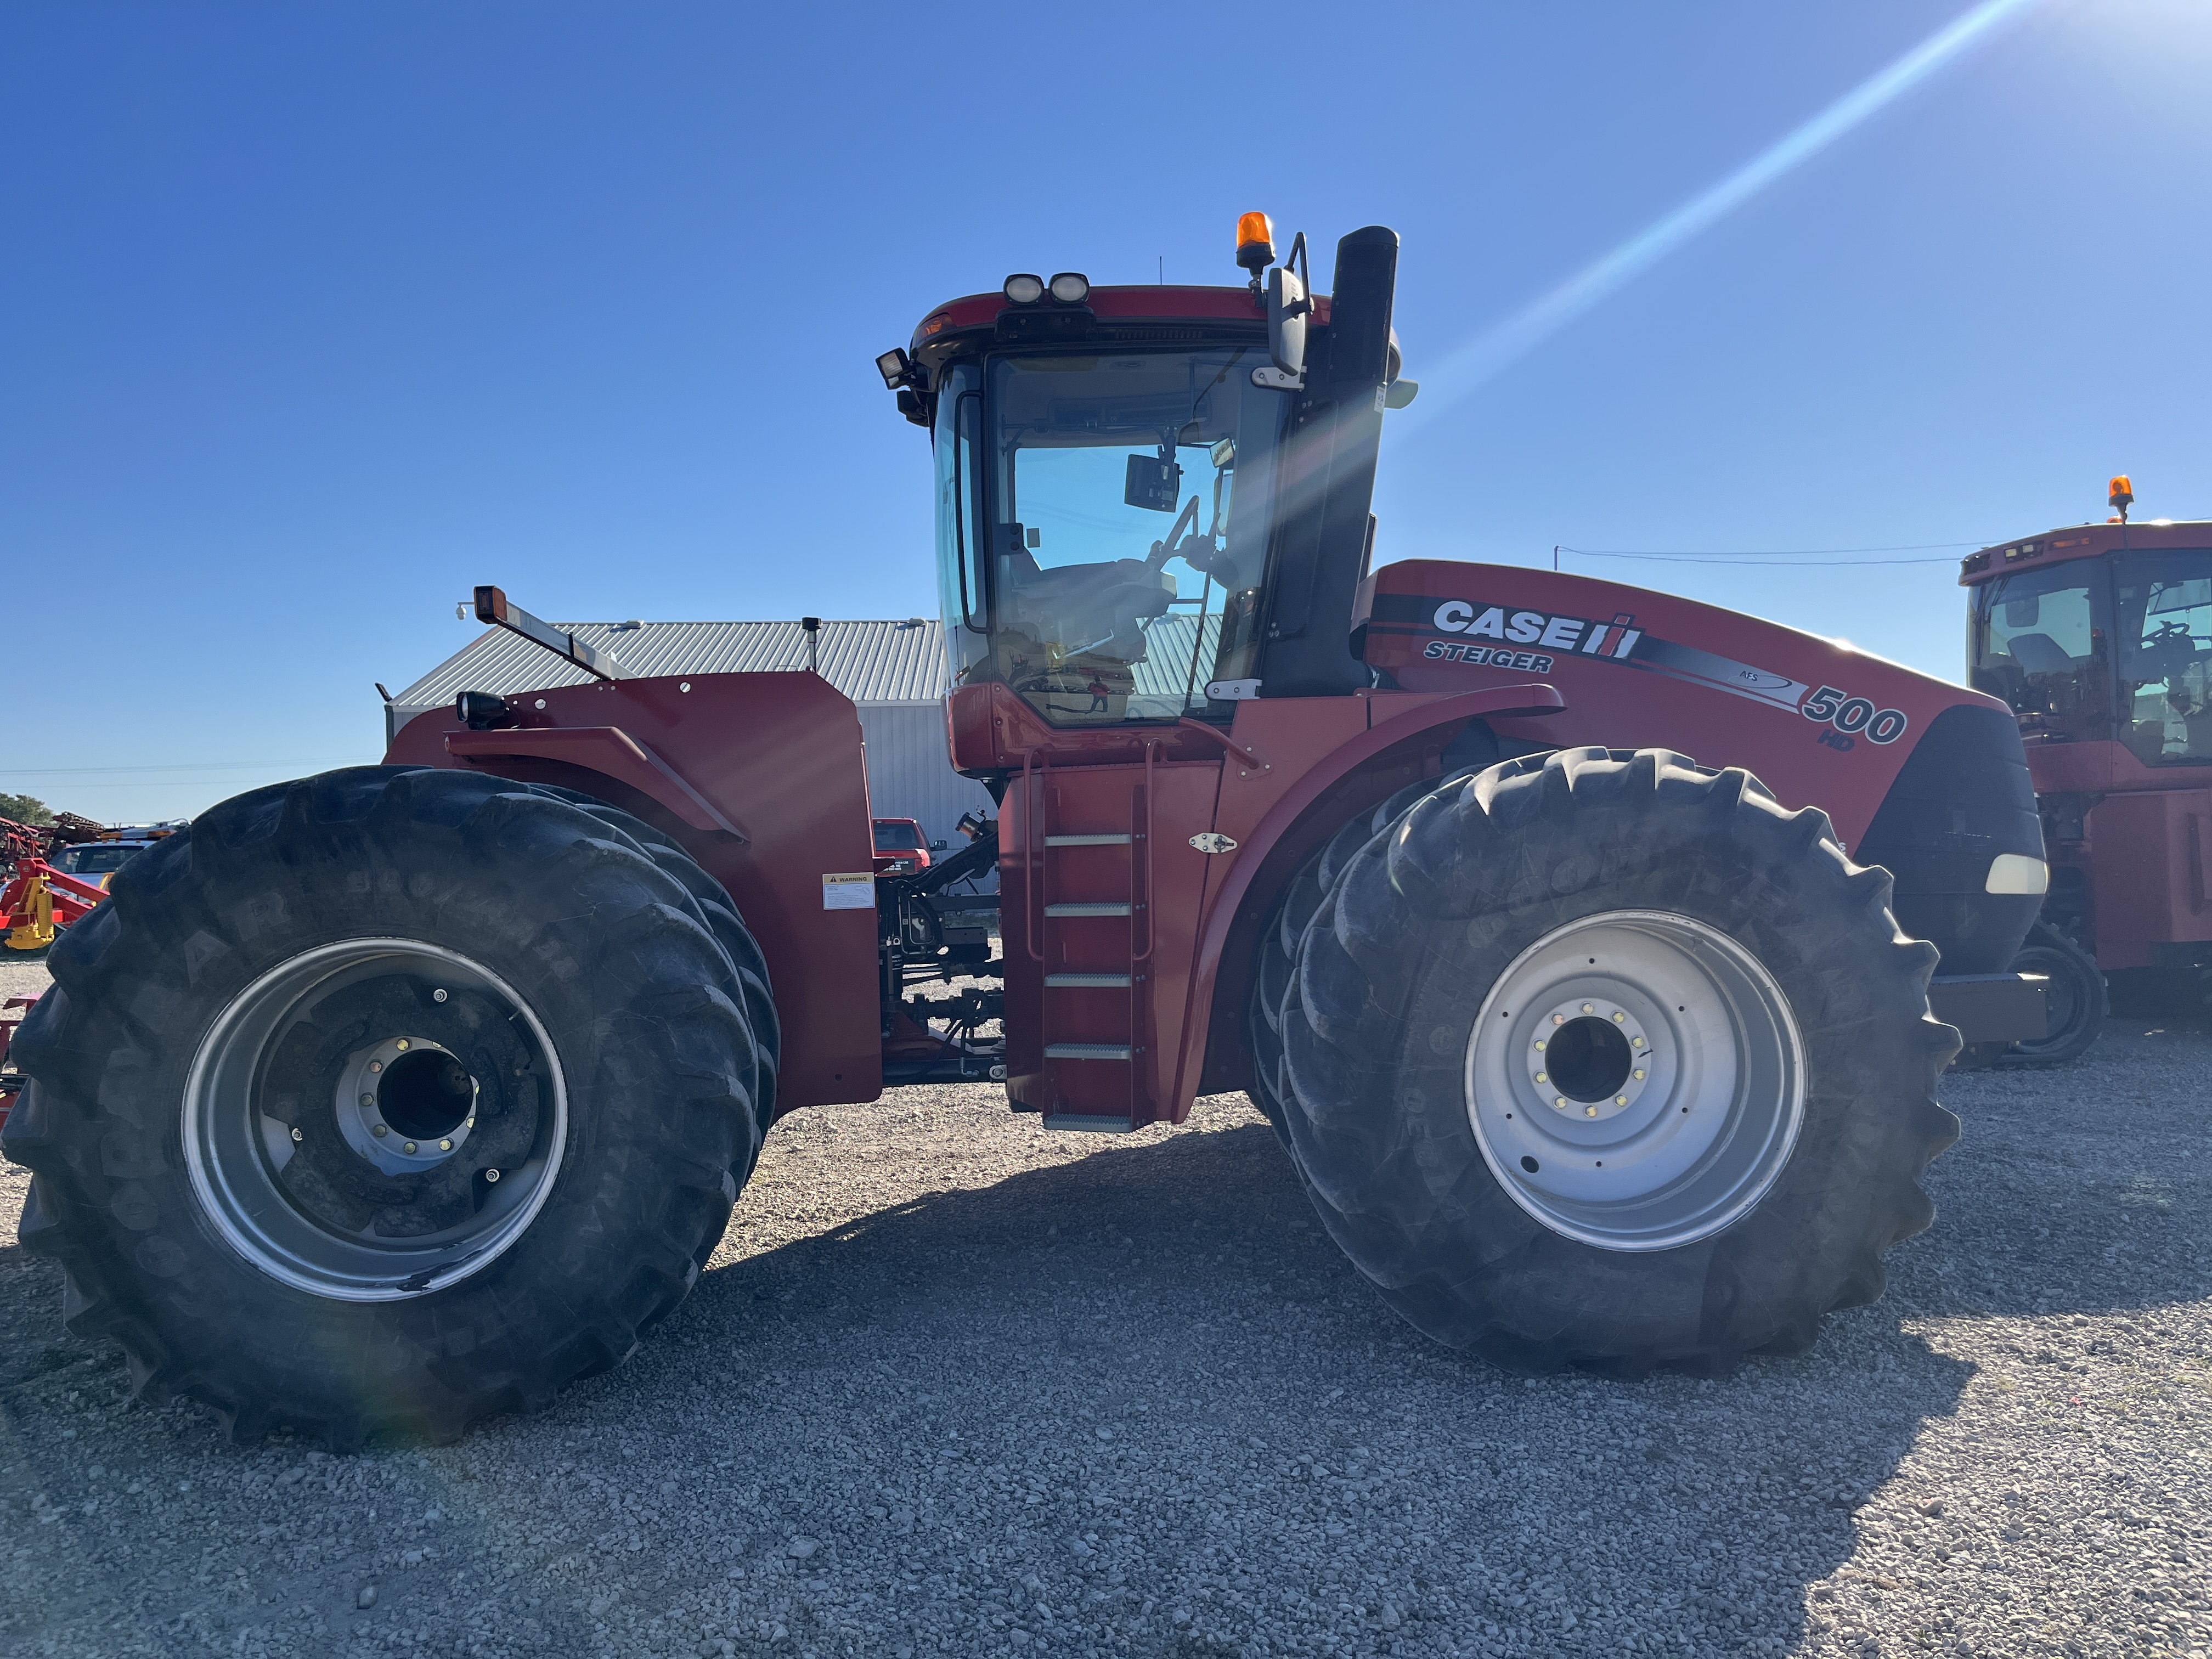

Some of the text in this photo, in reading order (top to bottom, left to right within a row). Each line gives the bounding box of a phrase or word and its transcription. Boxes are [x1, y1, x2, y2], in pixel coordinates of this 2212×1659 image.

[1433, 600, 1585, 650] CASE
[1423, 641, 1554, 674] STEIGER
[1740, 670, 1758, 681] AFS
[1801, 685, 1908, 745] 500
[1816, 729, 1855, 752] HD
